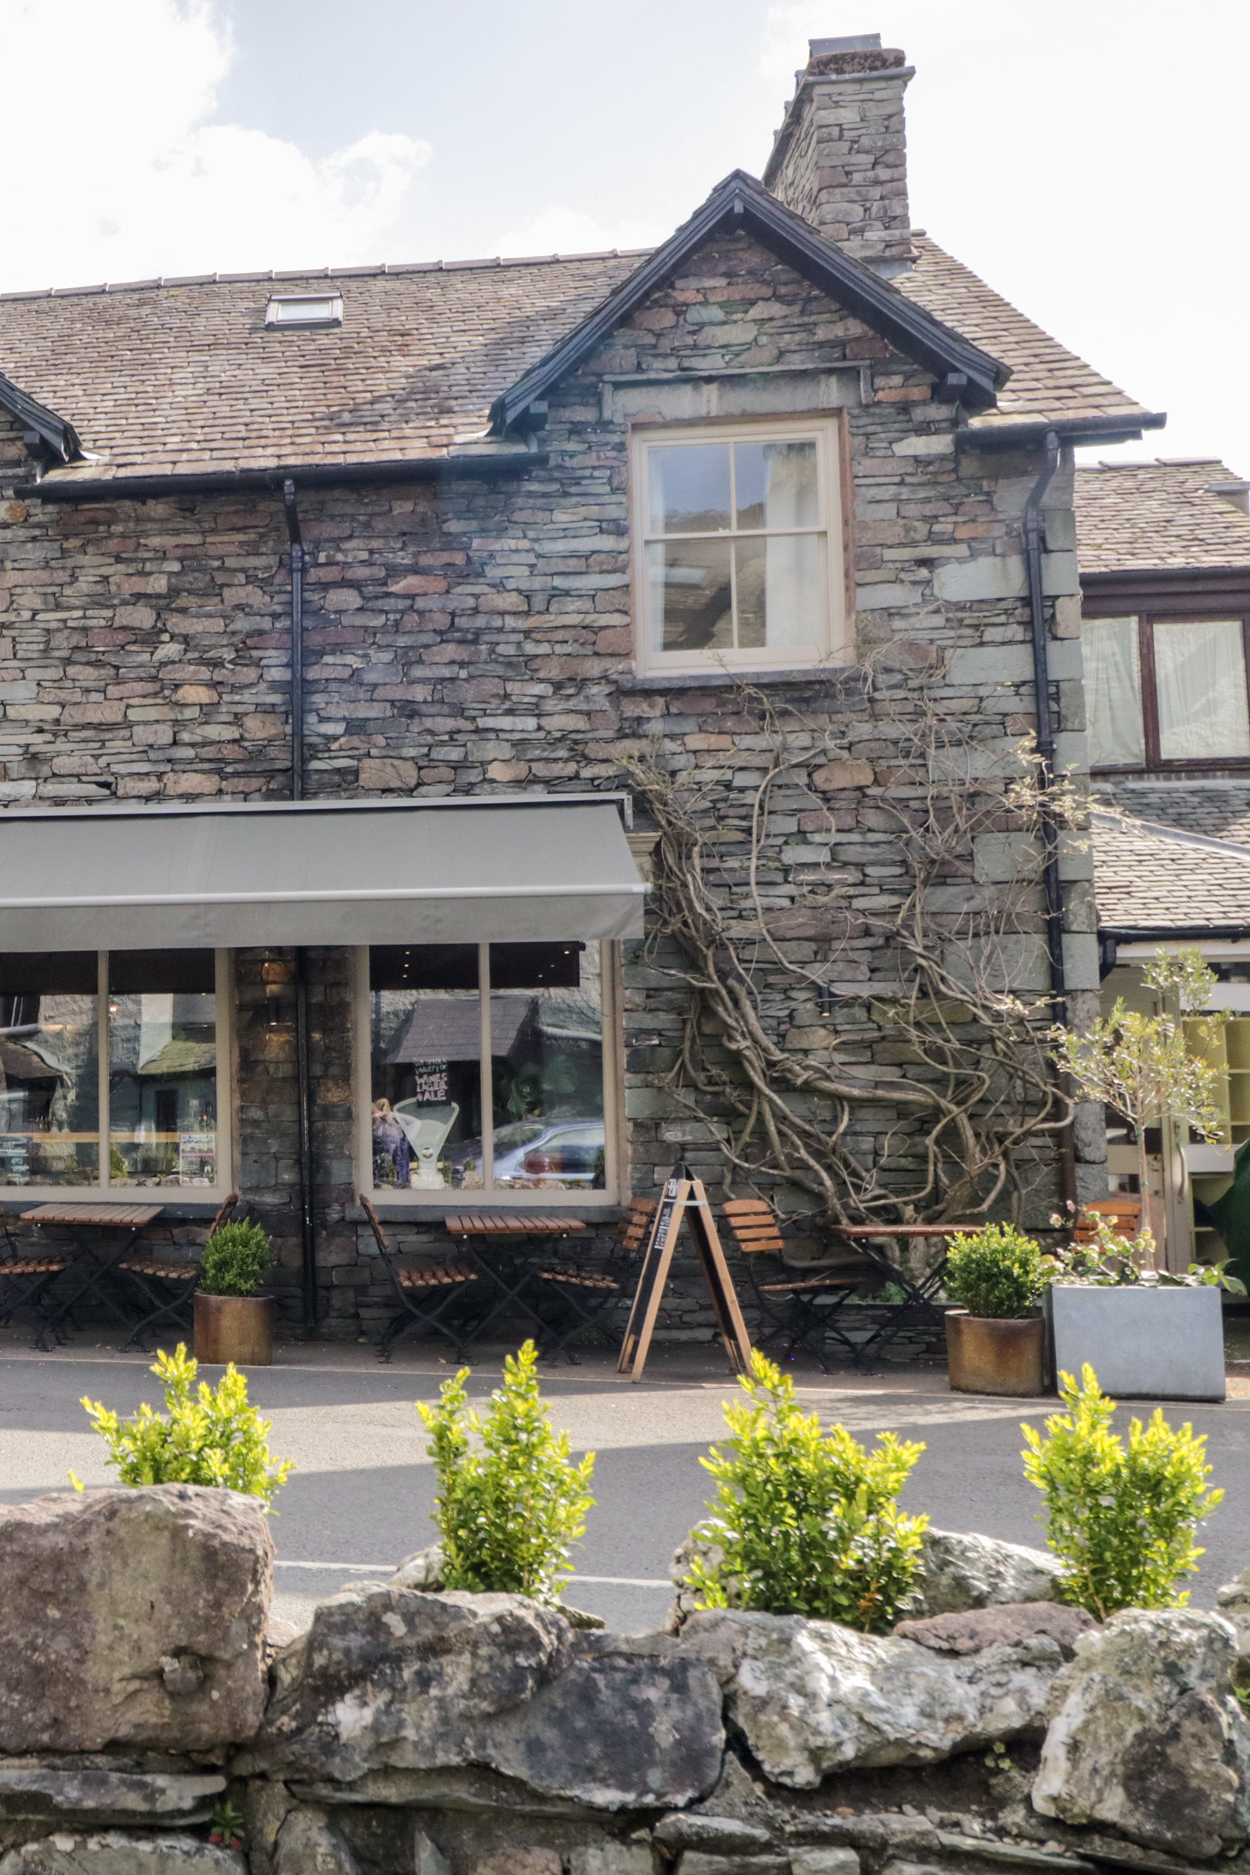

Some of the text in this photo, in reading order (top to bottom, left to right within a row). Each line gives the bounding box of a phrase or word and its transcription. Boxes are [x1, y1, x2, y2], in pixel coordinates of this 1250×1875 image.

[415, 1073, 448, 1084] WINES
[417, 1082, 448, 1092] LAGER
[424, 1090, 447, 1101] ALE
